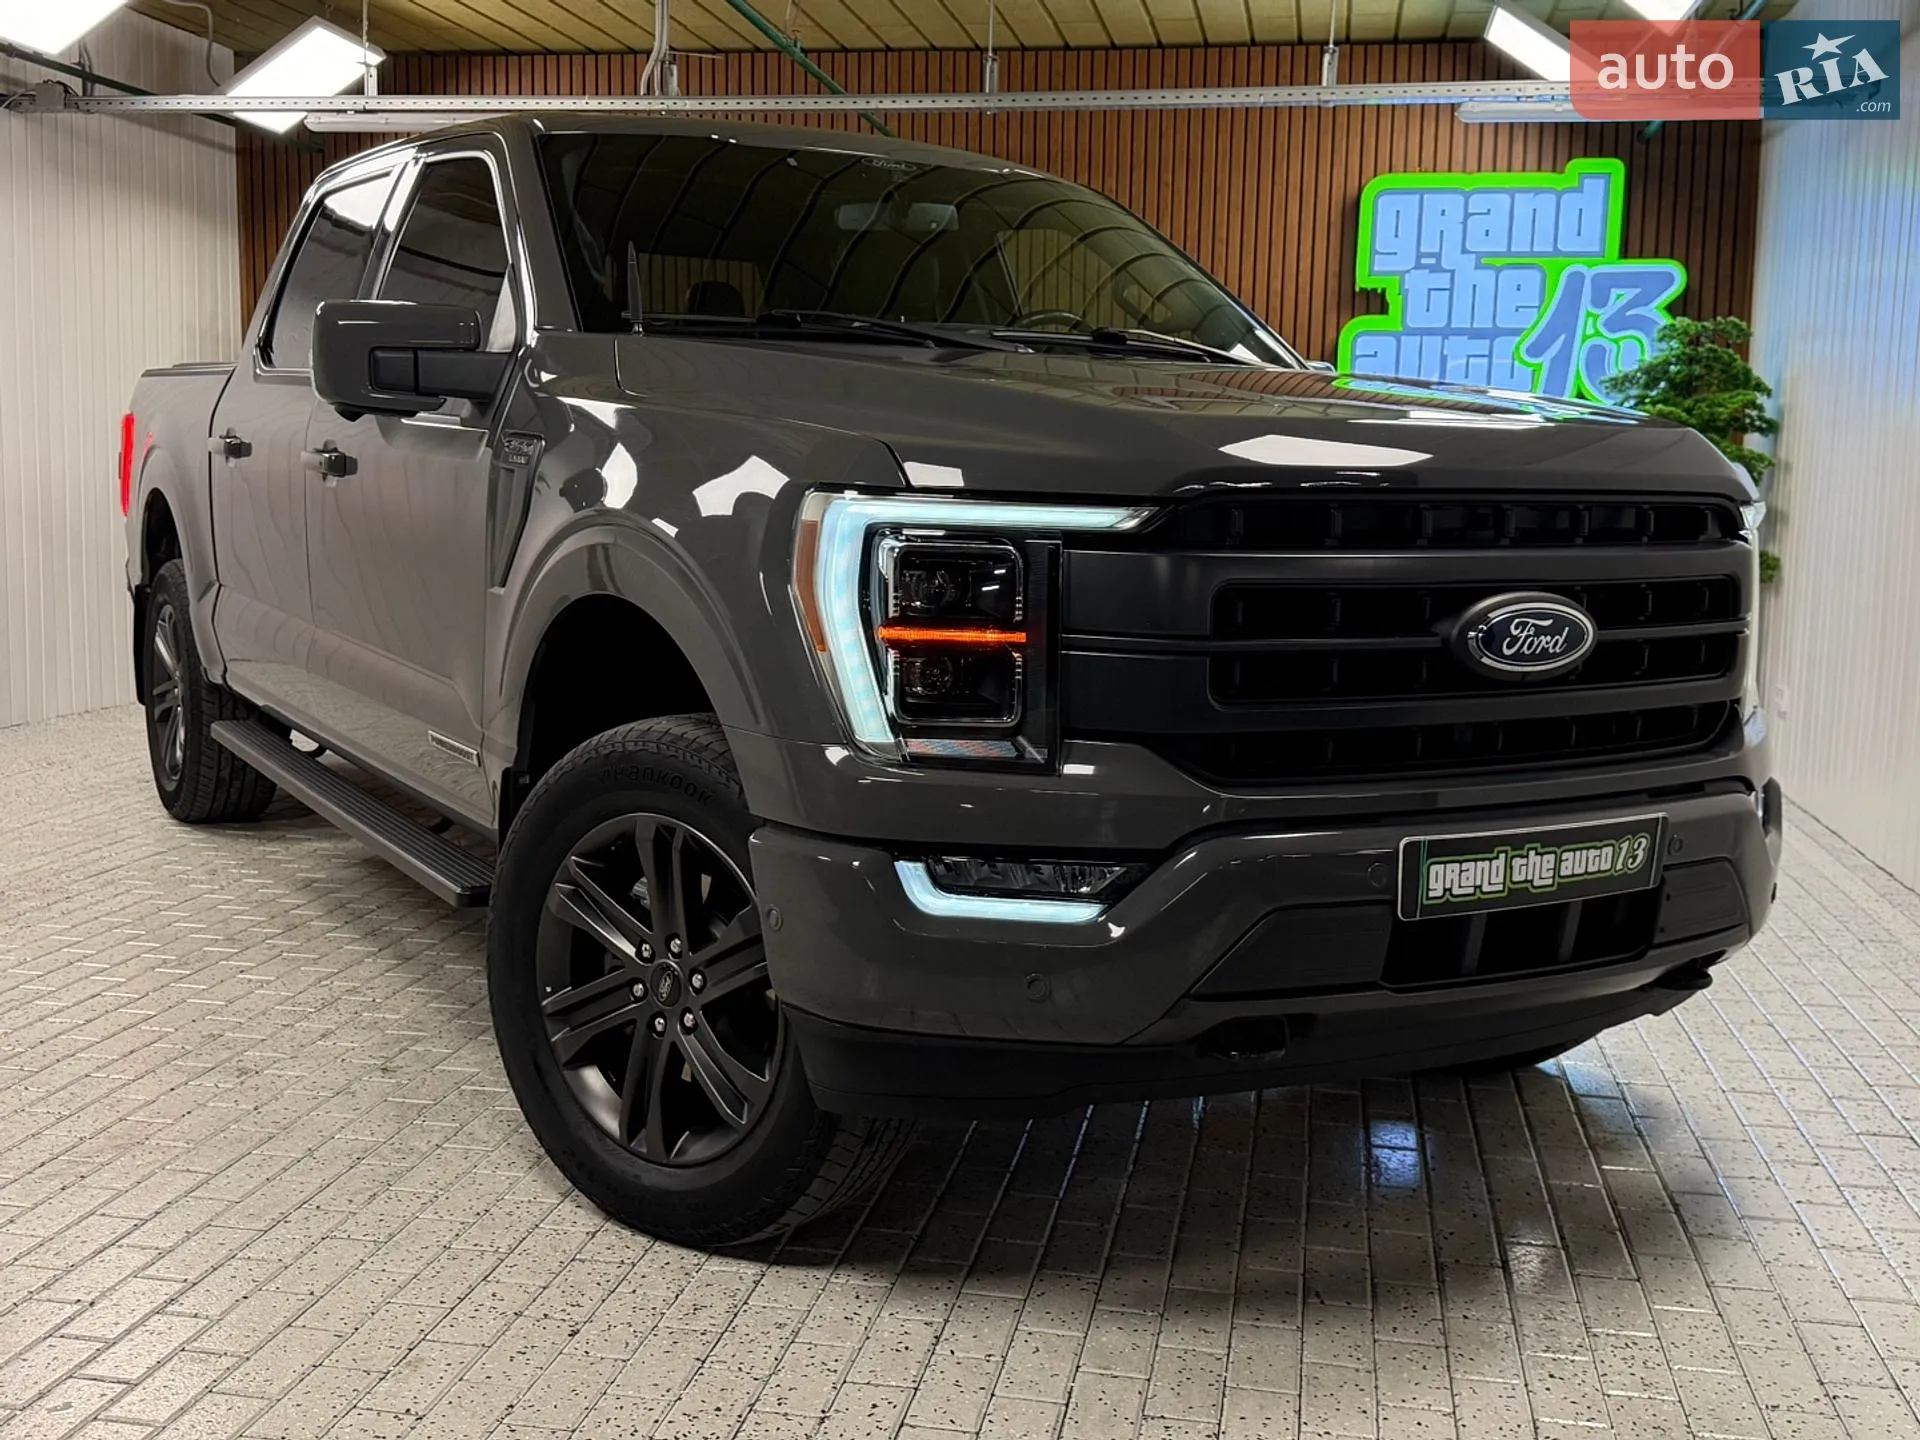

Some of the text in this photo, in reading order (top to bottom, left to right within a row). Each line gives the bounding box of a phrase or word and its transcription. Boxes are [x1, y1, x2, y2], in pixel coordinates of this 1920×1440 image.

[1373, 174, 1607, 271] grand
[1402, 254, 1547, 328] the
[1502, 617, 1569, 656] Ford
[1428, 853, 1506, 897] grand
[1511, 849, 1556, 887] the
